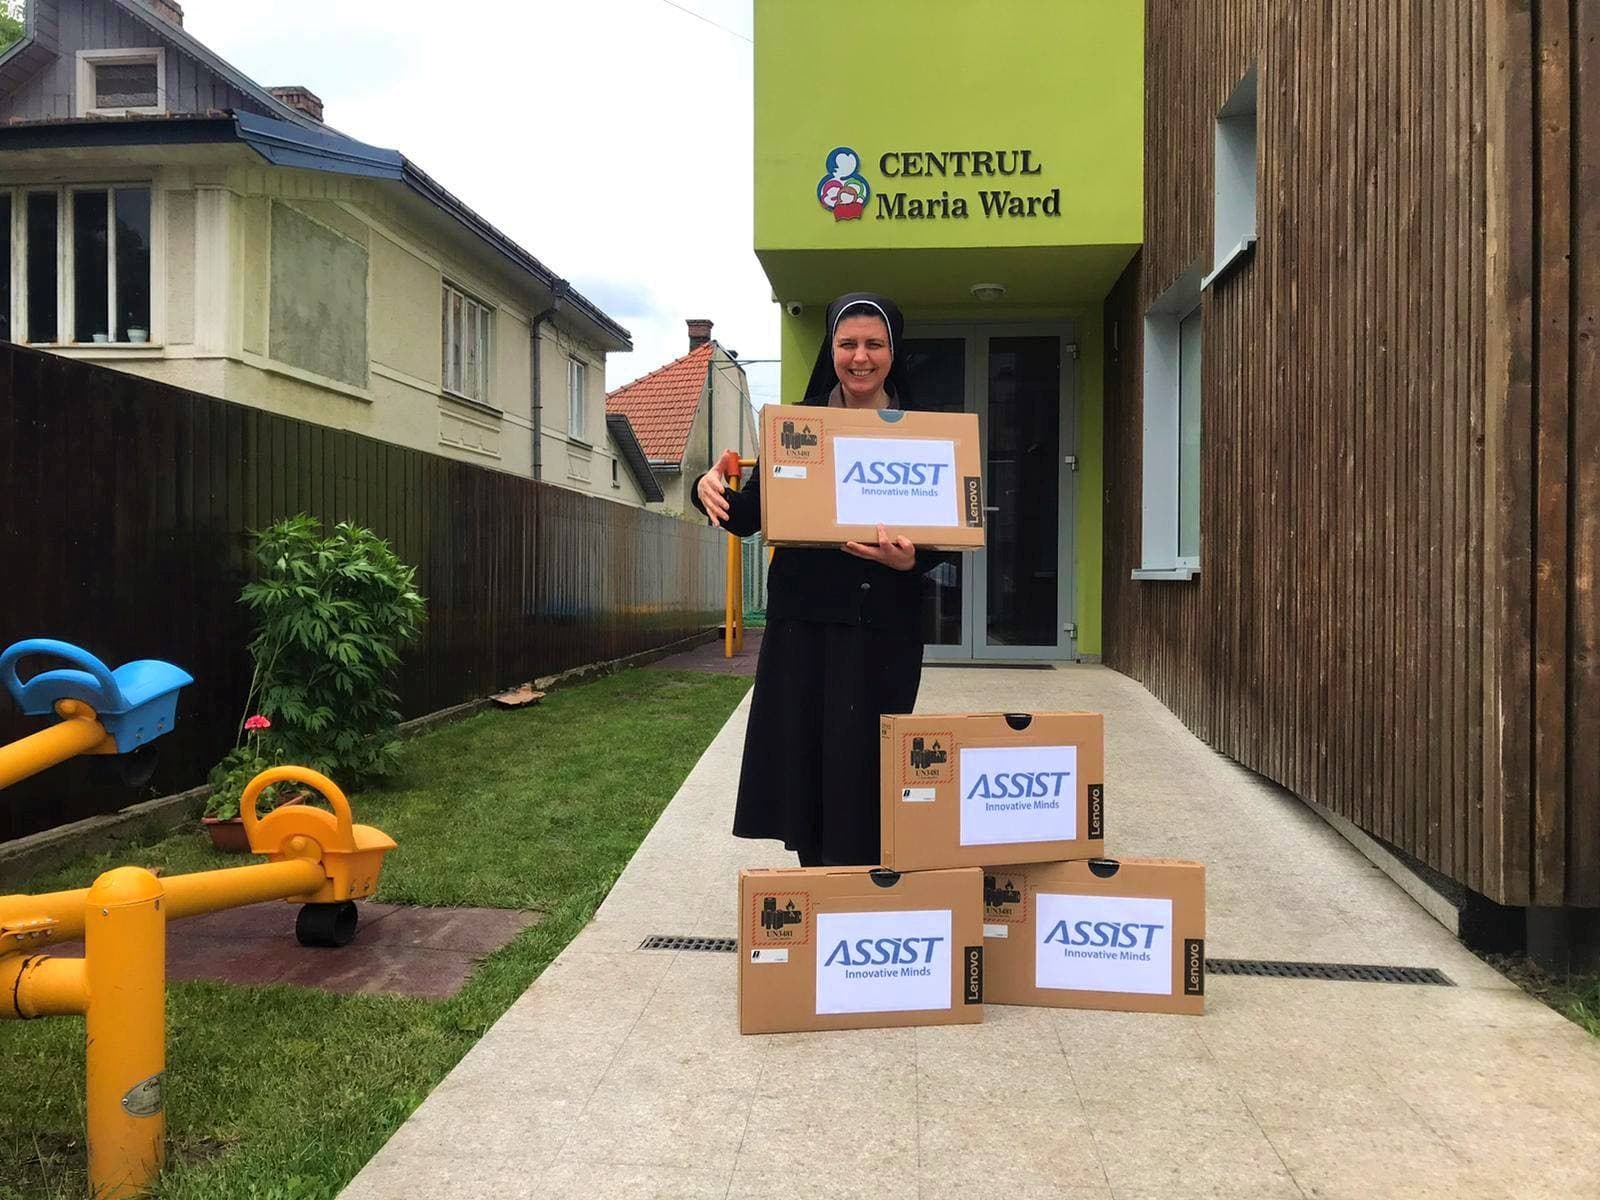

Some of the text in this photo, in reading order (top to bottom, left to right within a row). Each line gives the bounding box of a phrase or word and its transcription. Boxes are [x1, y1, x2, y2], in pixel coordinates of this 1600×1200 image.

[879, 150, 1042, 177] CENTRUL
[876, 188, 1062, 220] Maria Ward
[842, 461, 949, 486] ASSIST
[861, 487, 938, 498] Innovative Minds
[968, 480, 979, 525] Lenovo
[967, 772, 1071, 800] ASSIST
[985, 799, 1060, 811] Innovative Minds
[1091, 788, 1100, 836] Lenovo
[1043, 919, 1164, 949] ASSIST
[824, 937, 944, 967] ASSIST
[1064, 948, 1151, 962] Innovative Minds
[845, 967, 931, 979] Innovative Minds
[968, 950, 979, 1000] Lenovo
[1188, 943, 1200, 991] Lenovo
